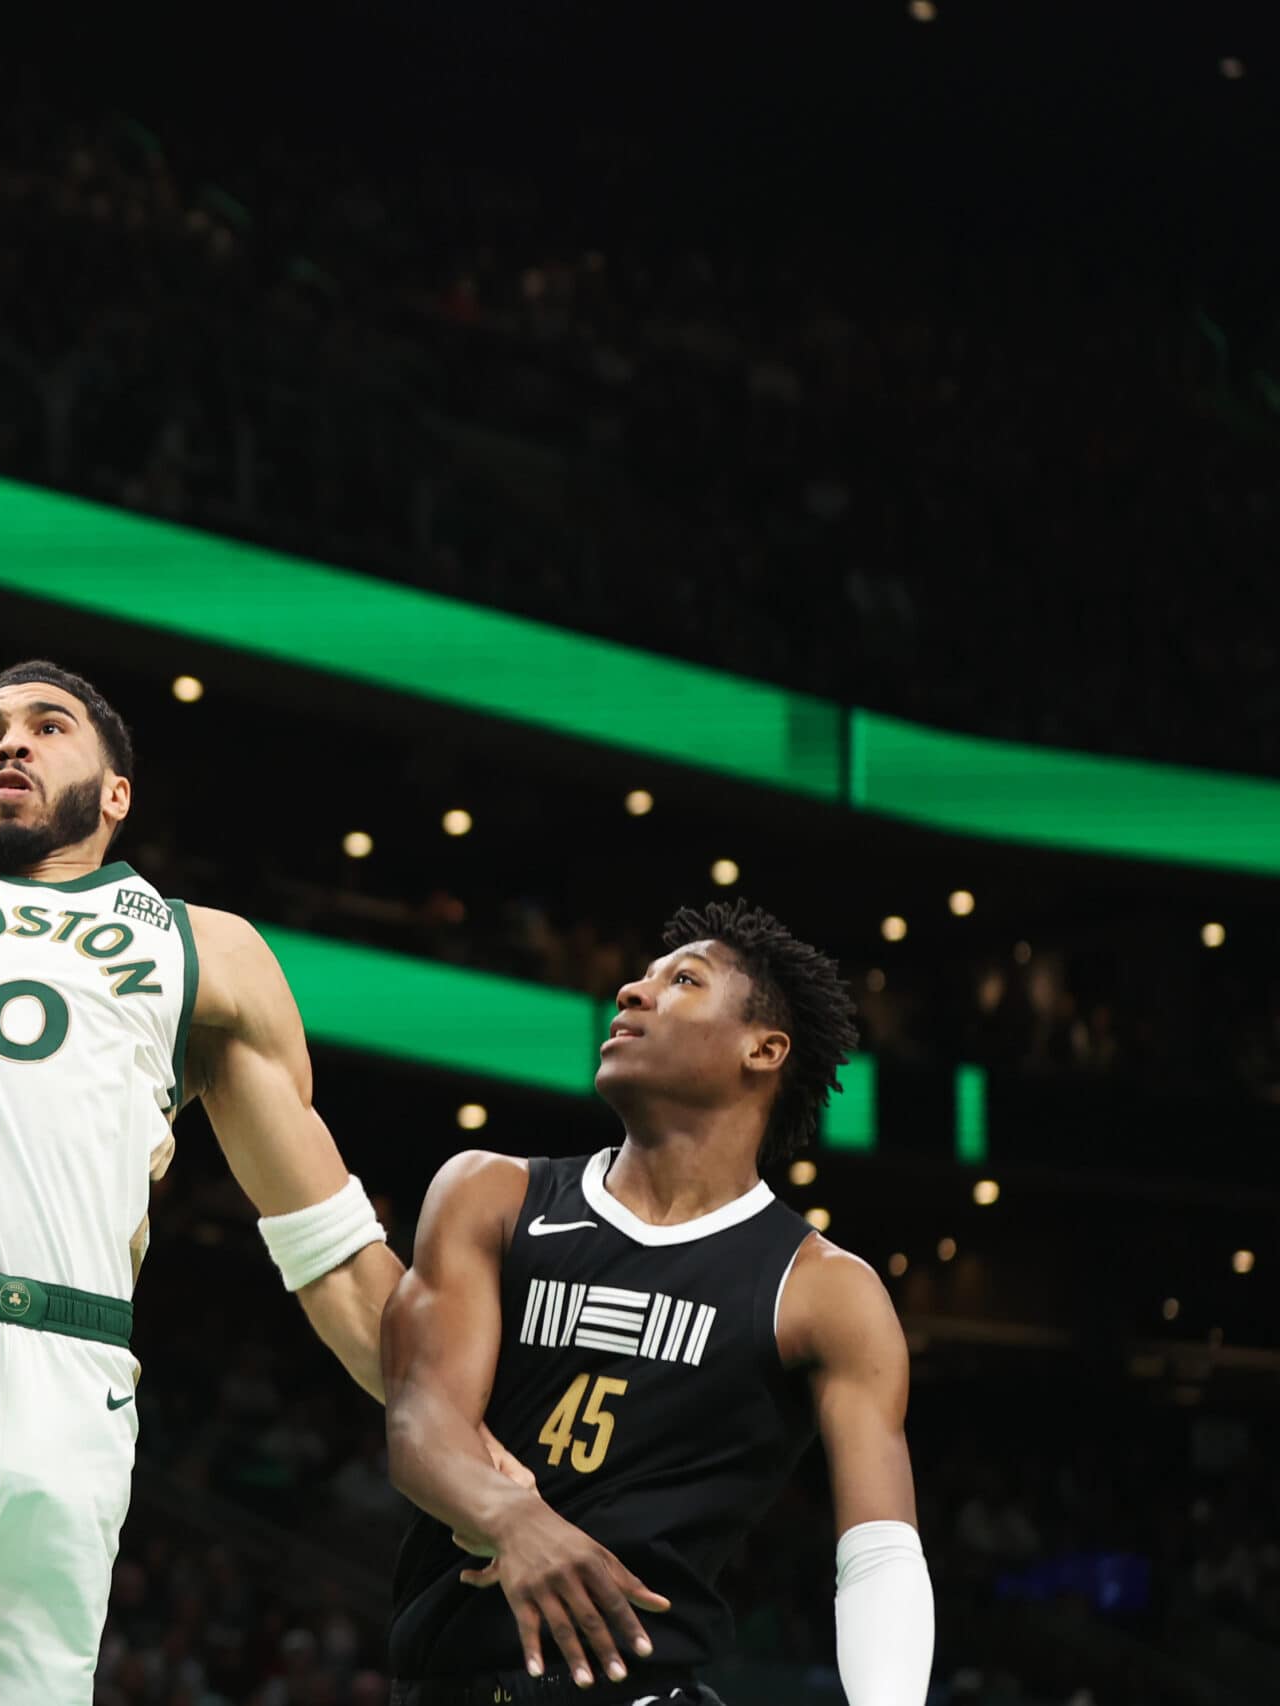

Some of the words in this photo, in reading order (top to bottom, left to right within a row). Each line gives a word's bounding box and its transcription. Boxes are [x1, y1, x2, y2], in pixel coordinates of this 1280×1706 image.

[116, 903, 169, 930] PRINT
[120, 890, 169, 923] VISTA
[538, 1373, 628, 1473] 45
